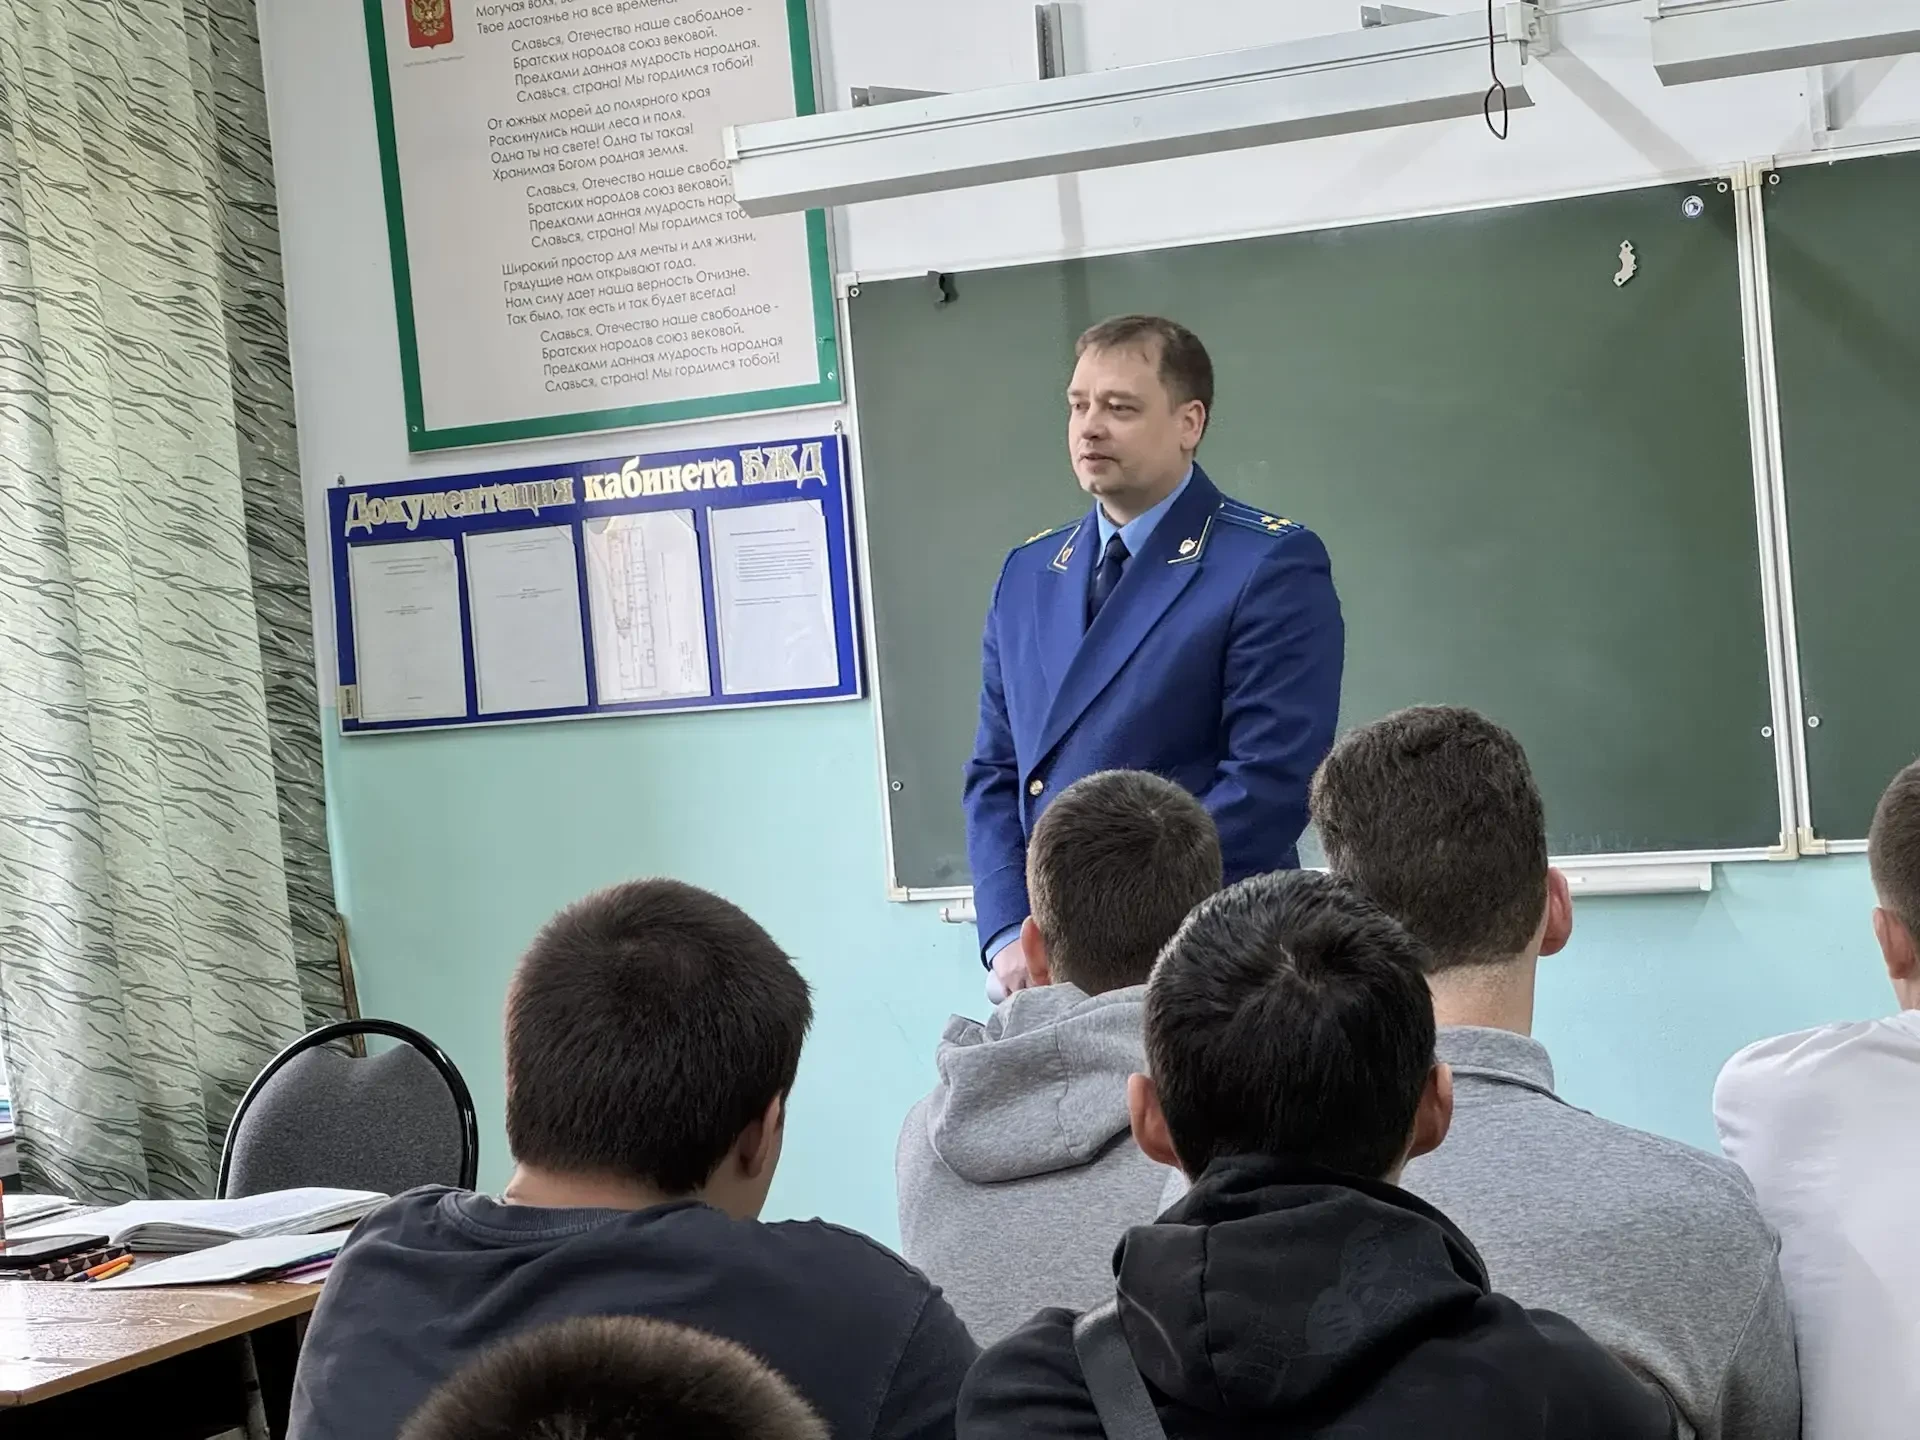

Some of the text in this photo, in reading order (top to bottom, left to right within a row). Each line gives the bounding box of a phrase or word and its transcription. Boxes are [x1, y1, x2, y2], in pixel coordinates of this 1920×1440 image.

[476, 1, 525, 17] Могучая
[477, 21, 504, 34] Твое
[507, 11, 569, 31] достоянье
[572, 8, 588, 19] на
[591, 3, 613, 17] все
[567, 24, 631, 43] Отечество
[634, 18, 670, 33] наше
[673, 5, 744, 26] свободное
[513, 52, 570, 71] Братских
[571, 42, 626, 60] народов
[628, 37, 661, 51] союз
[515, 68, 580, 87] Предками
[582, 59, 627, 77] данная
[630, 50, 692, 69] мудрость
[572, 75, 621, 95] страна!
[624, 74, 645, 86] Мы
[647, 64, 709, 83] гордимся
[711, 54, 753, 73] тобой!
[487, 87, 711, 131] От южных морей до полярного края
[489, 127, 568, 147] Раскинулись
[570, 122, 605, 135] наши
[608, 116, 640, 129] леса
[642, 115, 651, 124] и
[490, 122, 694, 164] Одна ты на свете! Одна ты такая!
[493, 163, 556, 182] Хранимая
[558, 157, 597, 172] Богом
[599, 149, 645, 168] родная
[581, 172, 646, 190] Отечество
[648, 166, 685, 180] наше
[528, 198, 584, 216] Братских
[586, 190, 640, 207] народов
[642, 185, 675, 198] союз
[529, 214, 594, 232] Предками
[596, 207, 641, 223] данная
[644, 198, 705, 216] мудрость
[586, 222, 636, 241] страна!
[639, 221, 659, 233] Мы
[661, 212, 723, 231] гордимся
[502, 256, 559, 276] Широкий
[561, 251, 614, 269] простор
[617, 248, 637, 260] для
[639, 243, 678, 257] мечты
[680, 242, 689, 250] и
[691, 238, 712, 250] для
[503, 275, 564, 294] Грядущие
[566, 272, 594, 284] нам
[596, 262, 661, 280] открывают
[505, 296, 533, 309] Нам
[535, 292, 564, 305] силу
[566, 288, 595, 302] дает
[598, 283, 634, 296] наша
[637, 275, 694, 292] верность
[507, 313, 528, 325] Так
[566, 306, 586, 317] так
[588, 303, 616, 315] есть
[617, 302, 626, 310] и
[628, 298, 649, 309] так
[651, 292, 686, 308] будет
[689, 283, 736, 301] всегда!
[595, 318, 659, 336] Отечество
[662, 313, 698, 327] наше
[700, 303, 771, 322] свободное
[541, 344, 597, 361] Братских
[599, 336, 654, 352] народов
[655, 331, 688, 345] союз
[543, 336, 783, 377] Предками данная мудрость народная
[600, 368, 649, 386] страна!
[652, 367, 672, 379] Мы
[675, 359, 735, 376] гордимся
[739, 351, 780, 368] тобой!
[346, 442, 827, 536] Документация кабинета БЖД
